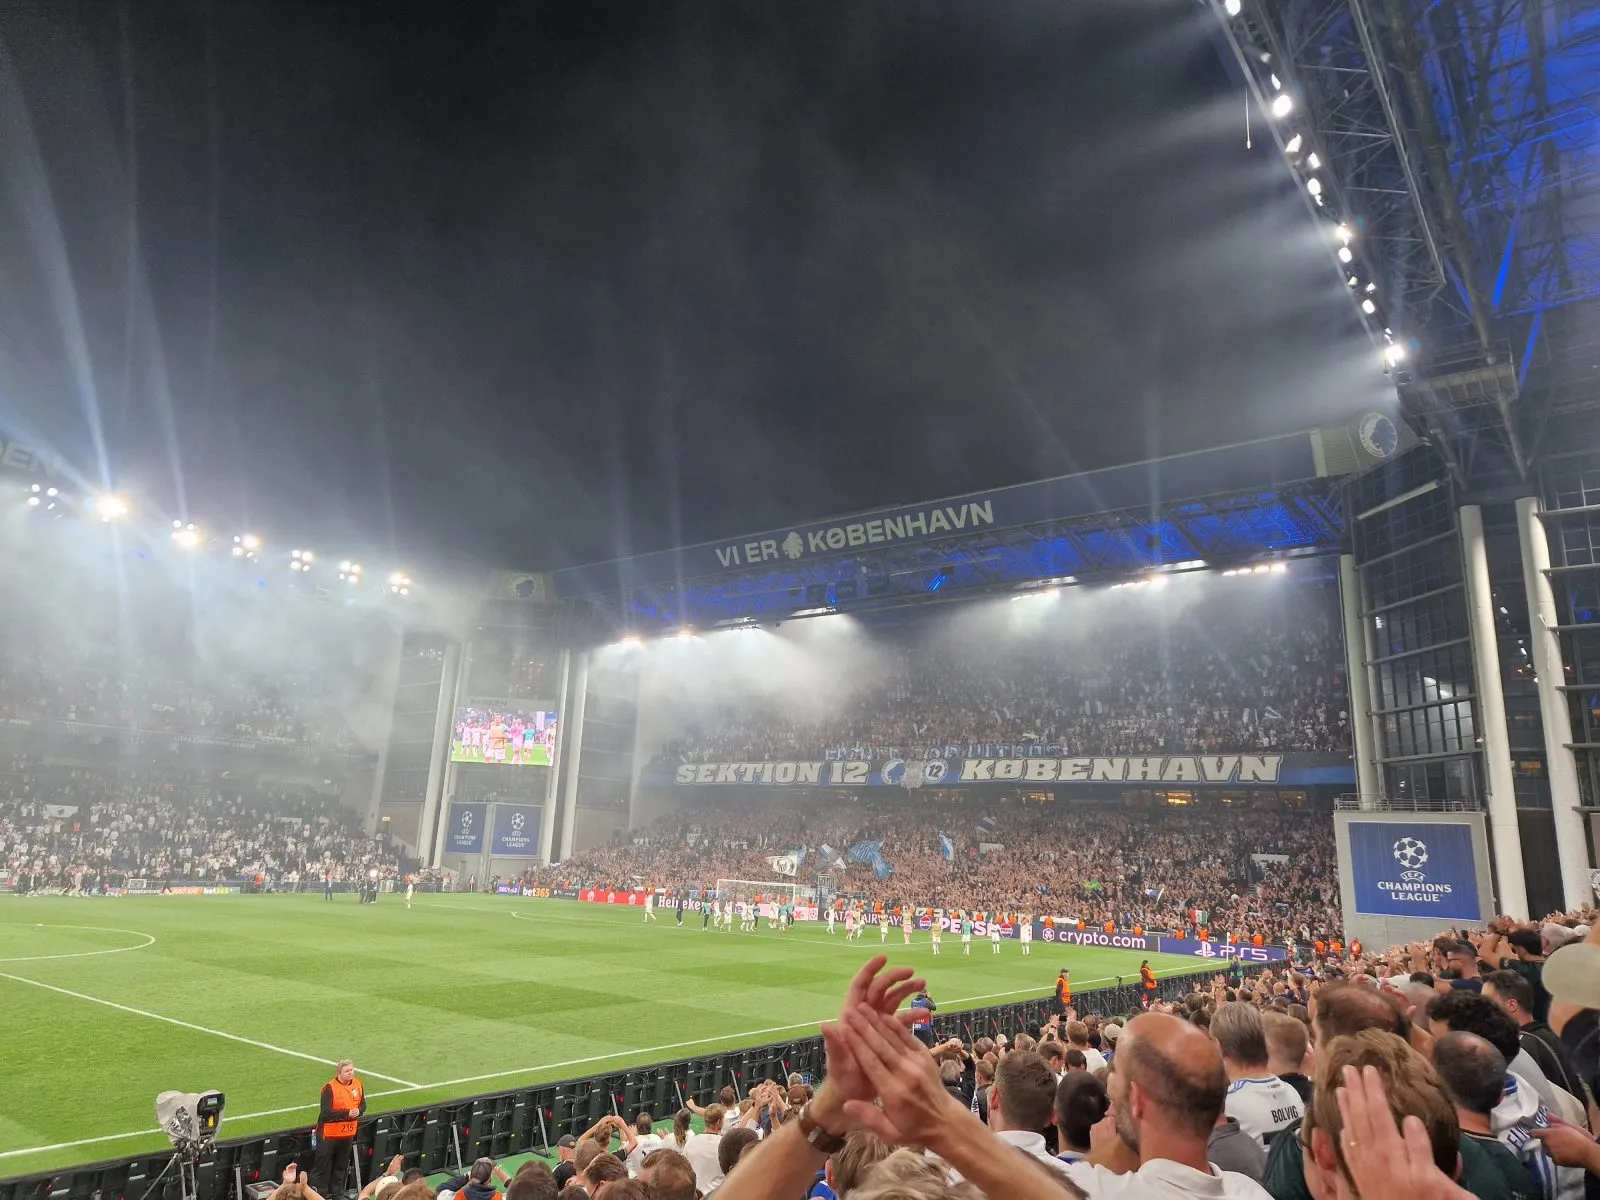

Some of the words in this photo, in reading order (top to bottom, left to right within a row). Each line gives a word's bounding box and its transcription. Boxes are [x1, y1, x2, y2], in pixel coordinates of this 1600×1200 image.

[715, 545, 740, 567] VI
[745, 539, 779, 563] ER
[807, 500, 994, 553] KØBENHAVN
[675, 762, 823, 784] SEKTION
[830, 761, 871, 784] 12
[960, 756, 1283, 783] KØBENHAVN
[928, 765, 943, 778] 12
[1401, 872, 1424, 881] UEFA
[523, 887, 550, 897] bet365
[1377, 881, 1452, 893] CHAMPIONS
[1391, 892, 1440, 902] LEAGUE
[1059, 931, 1146, 951] crypto.com
[1220, 945, 1268, 961] PS5
[1271, 1105, 1299, 1124] BOLVIG
